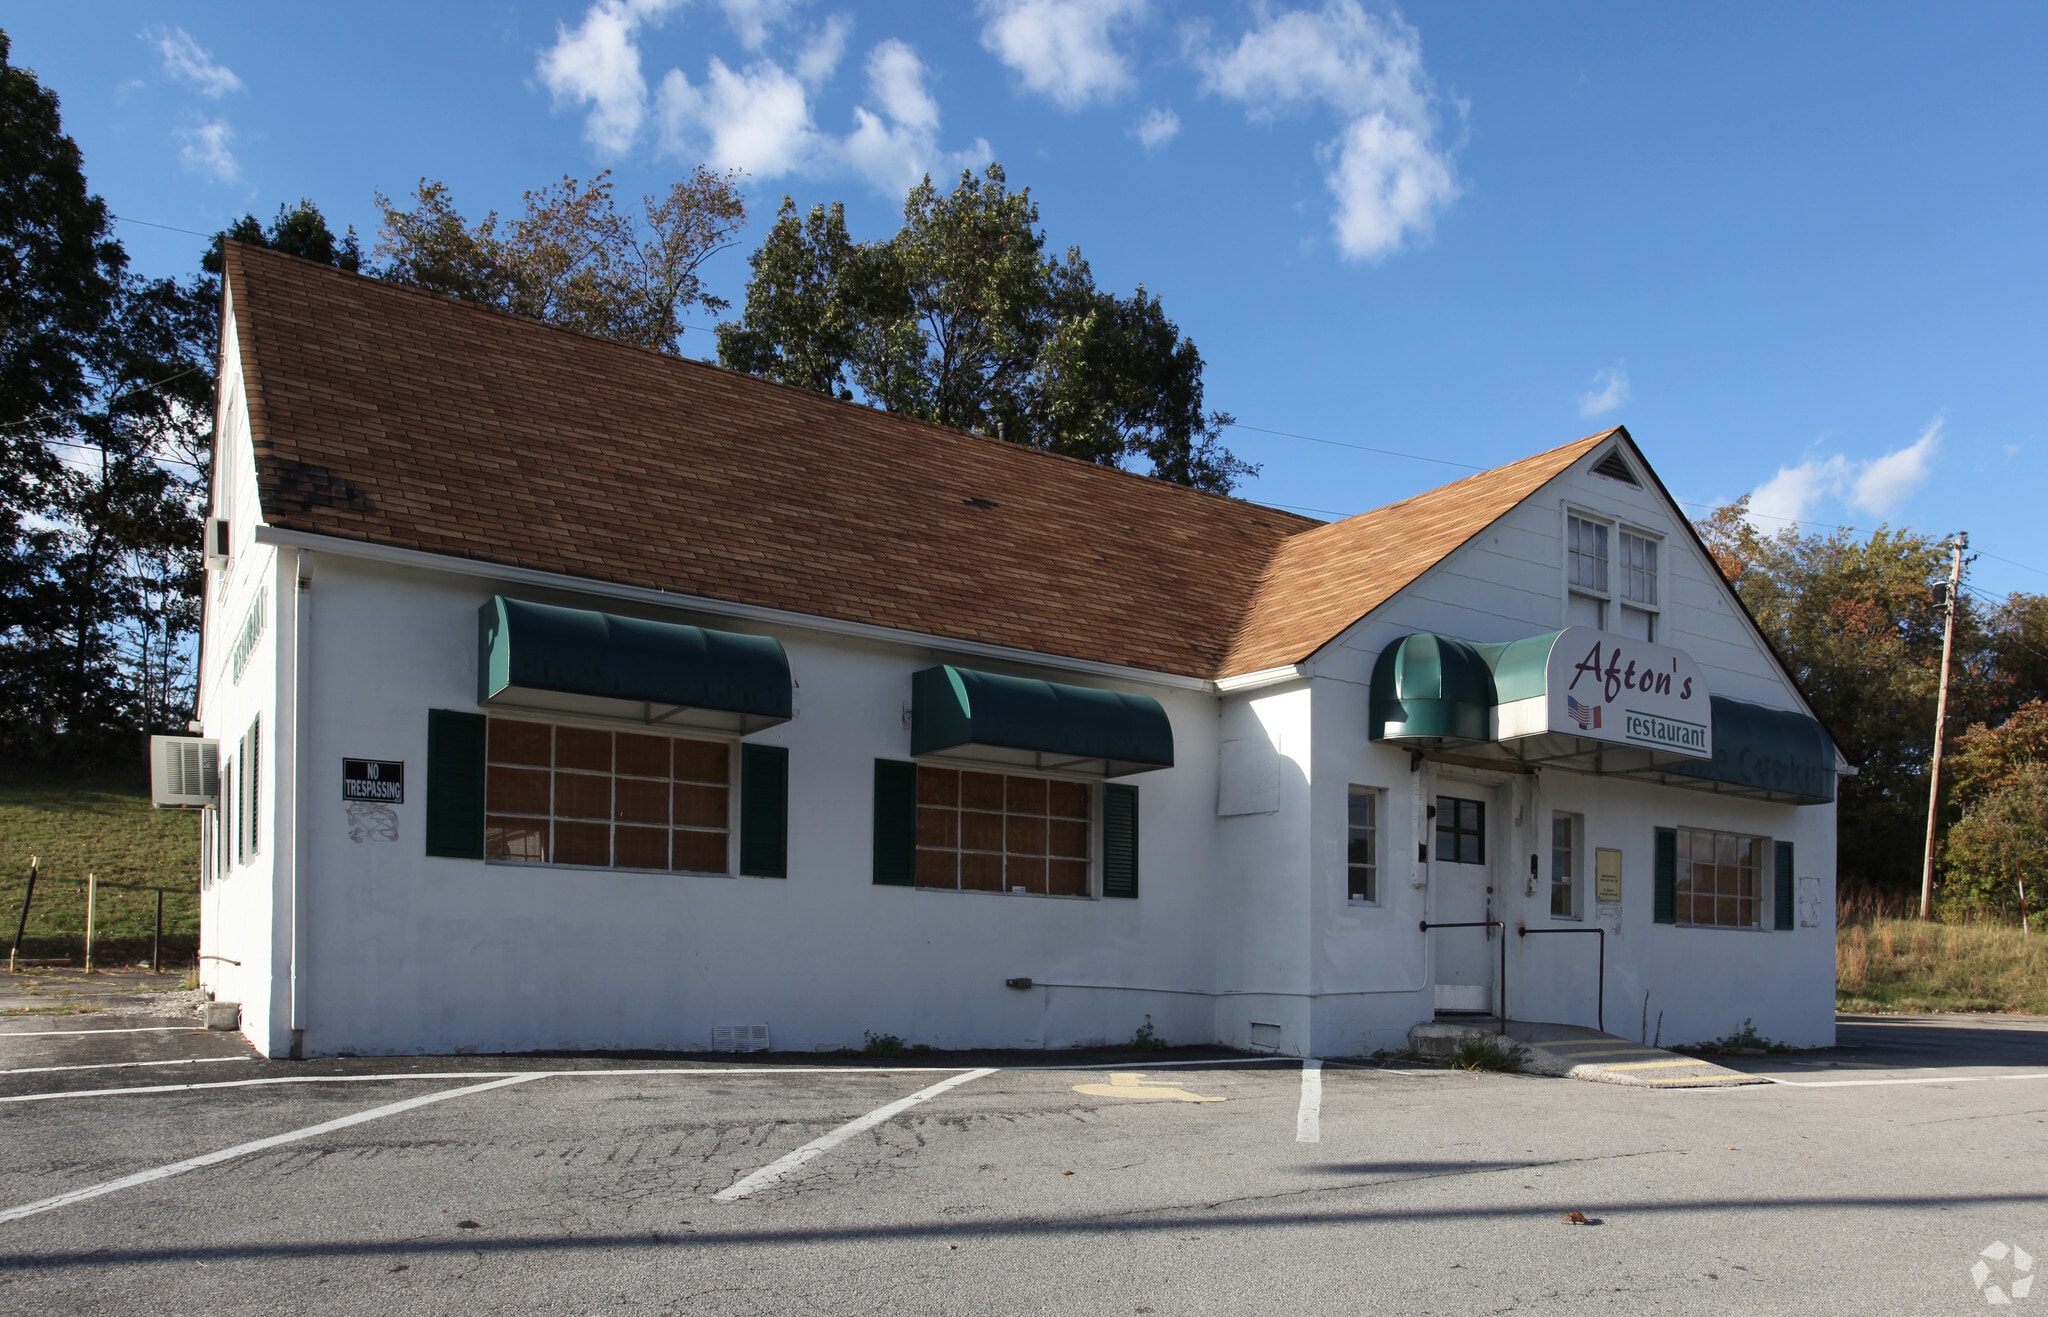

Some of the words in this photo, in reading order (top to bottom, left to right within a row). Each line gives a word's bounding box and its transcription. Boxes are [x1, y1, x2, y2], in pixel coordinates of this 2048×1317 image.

[1569, 640, 1692, 703] Afton's
[1626, 715, 1706, 748] restaurant
[367, 763, 379, 779] NO
[346, 779, 401, 798] TRESPASSING
